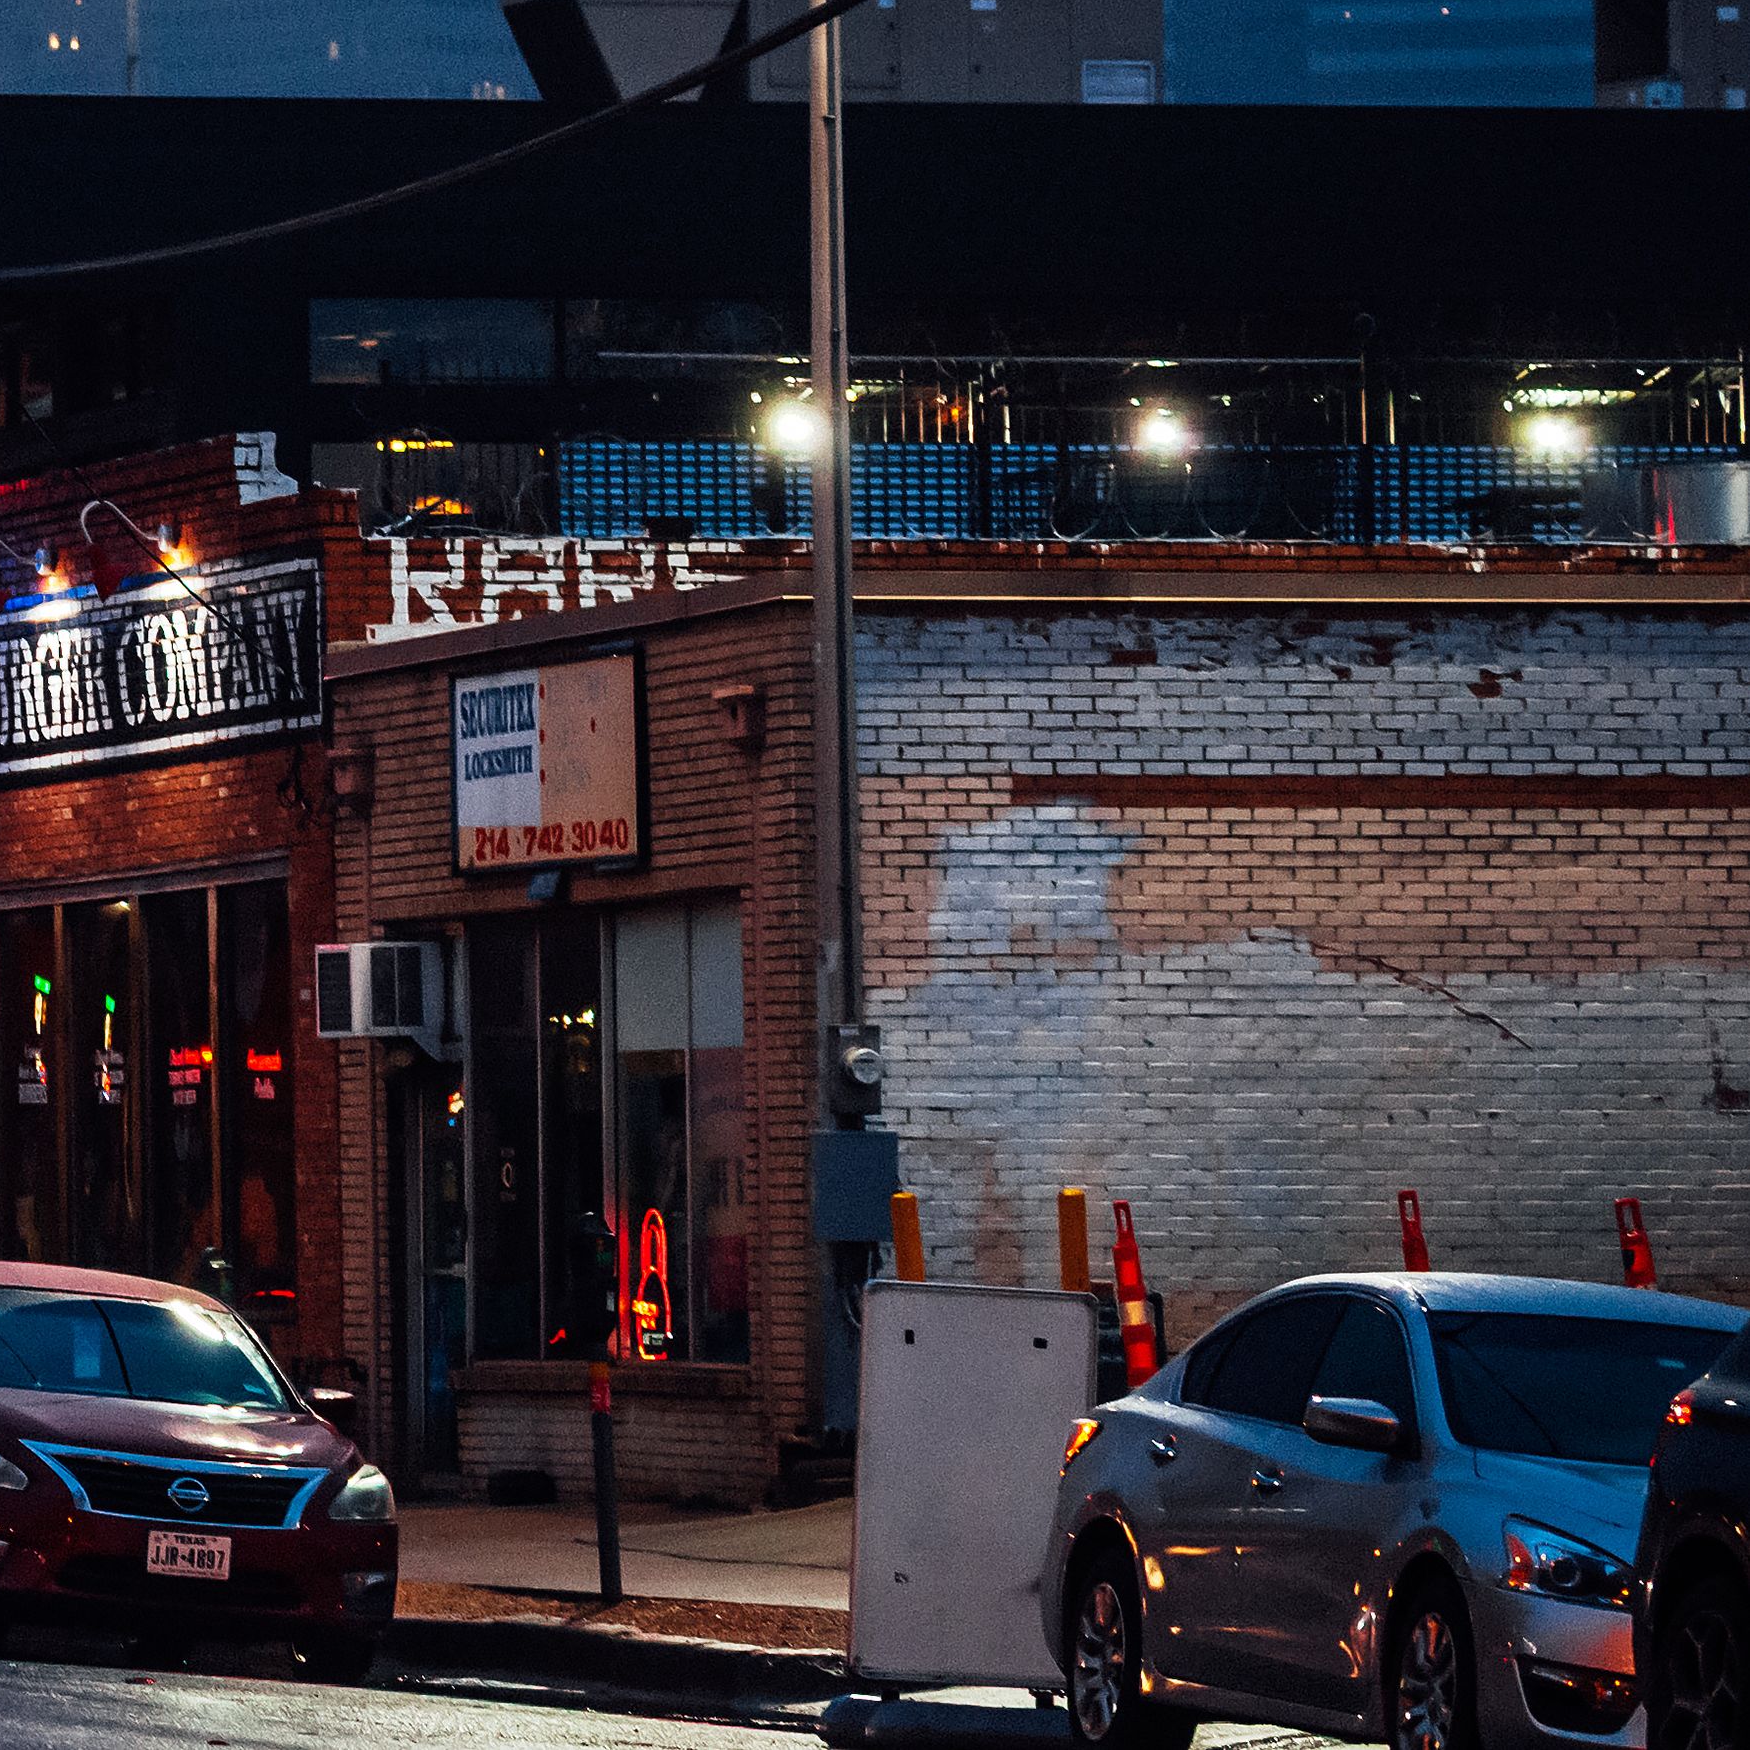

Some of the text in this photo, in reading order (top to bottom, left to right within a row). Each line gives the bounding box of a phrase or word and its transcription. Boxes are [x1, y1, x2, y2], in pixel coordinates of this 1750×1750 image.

[115, 588, 307, 726] COMPANY
[464, 744, 534, 782] LOCKSMITH
[474, 817, 629, 862] 214 742 3040
[173, 1534, 207, 1546] TEXAS
